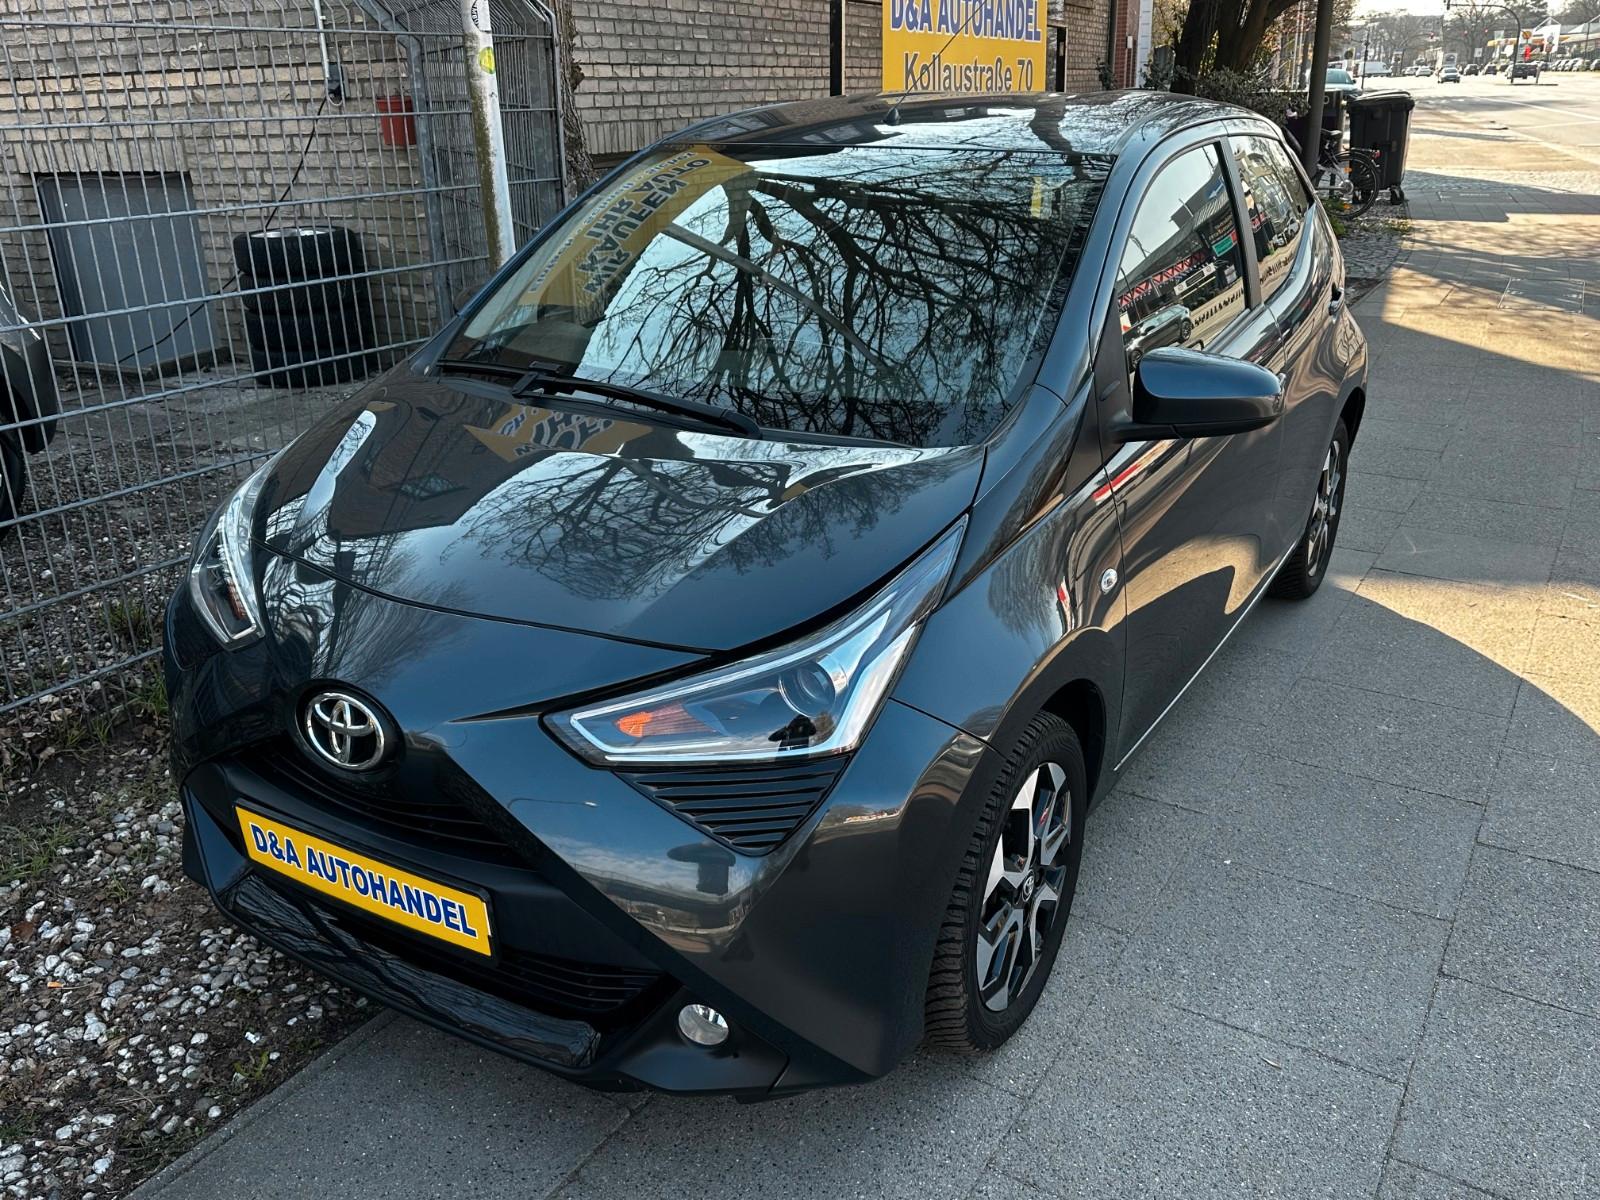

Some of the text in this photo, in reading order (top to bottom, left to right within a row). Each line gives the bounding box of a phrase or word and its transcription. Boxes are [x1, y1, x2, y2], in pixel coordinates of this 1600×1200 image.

[890, 0, 1042, 42] D&A AUTOHANDEL
[904, 51, 1034, 92] Kollaustraße 70
[249, 821, 479, 939] D&A AUTOHANDEL
